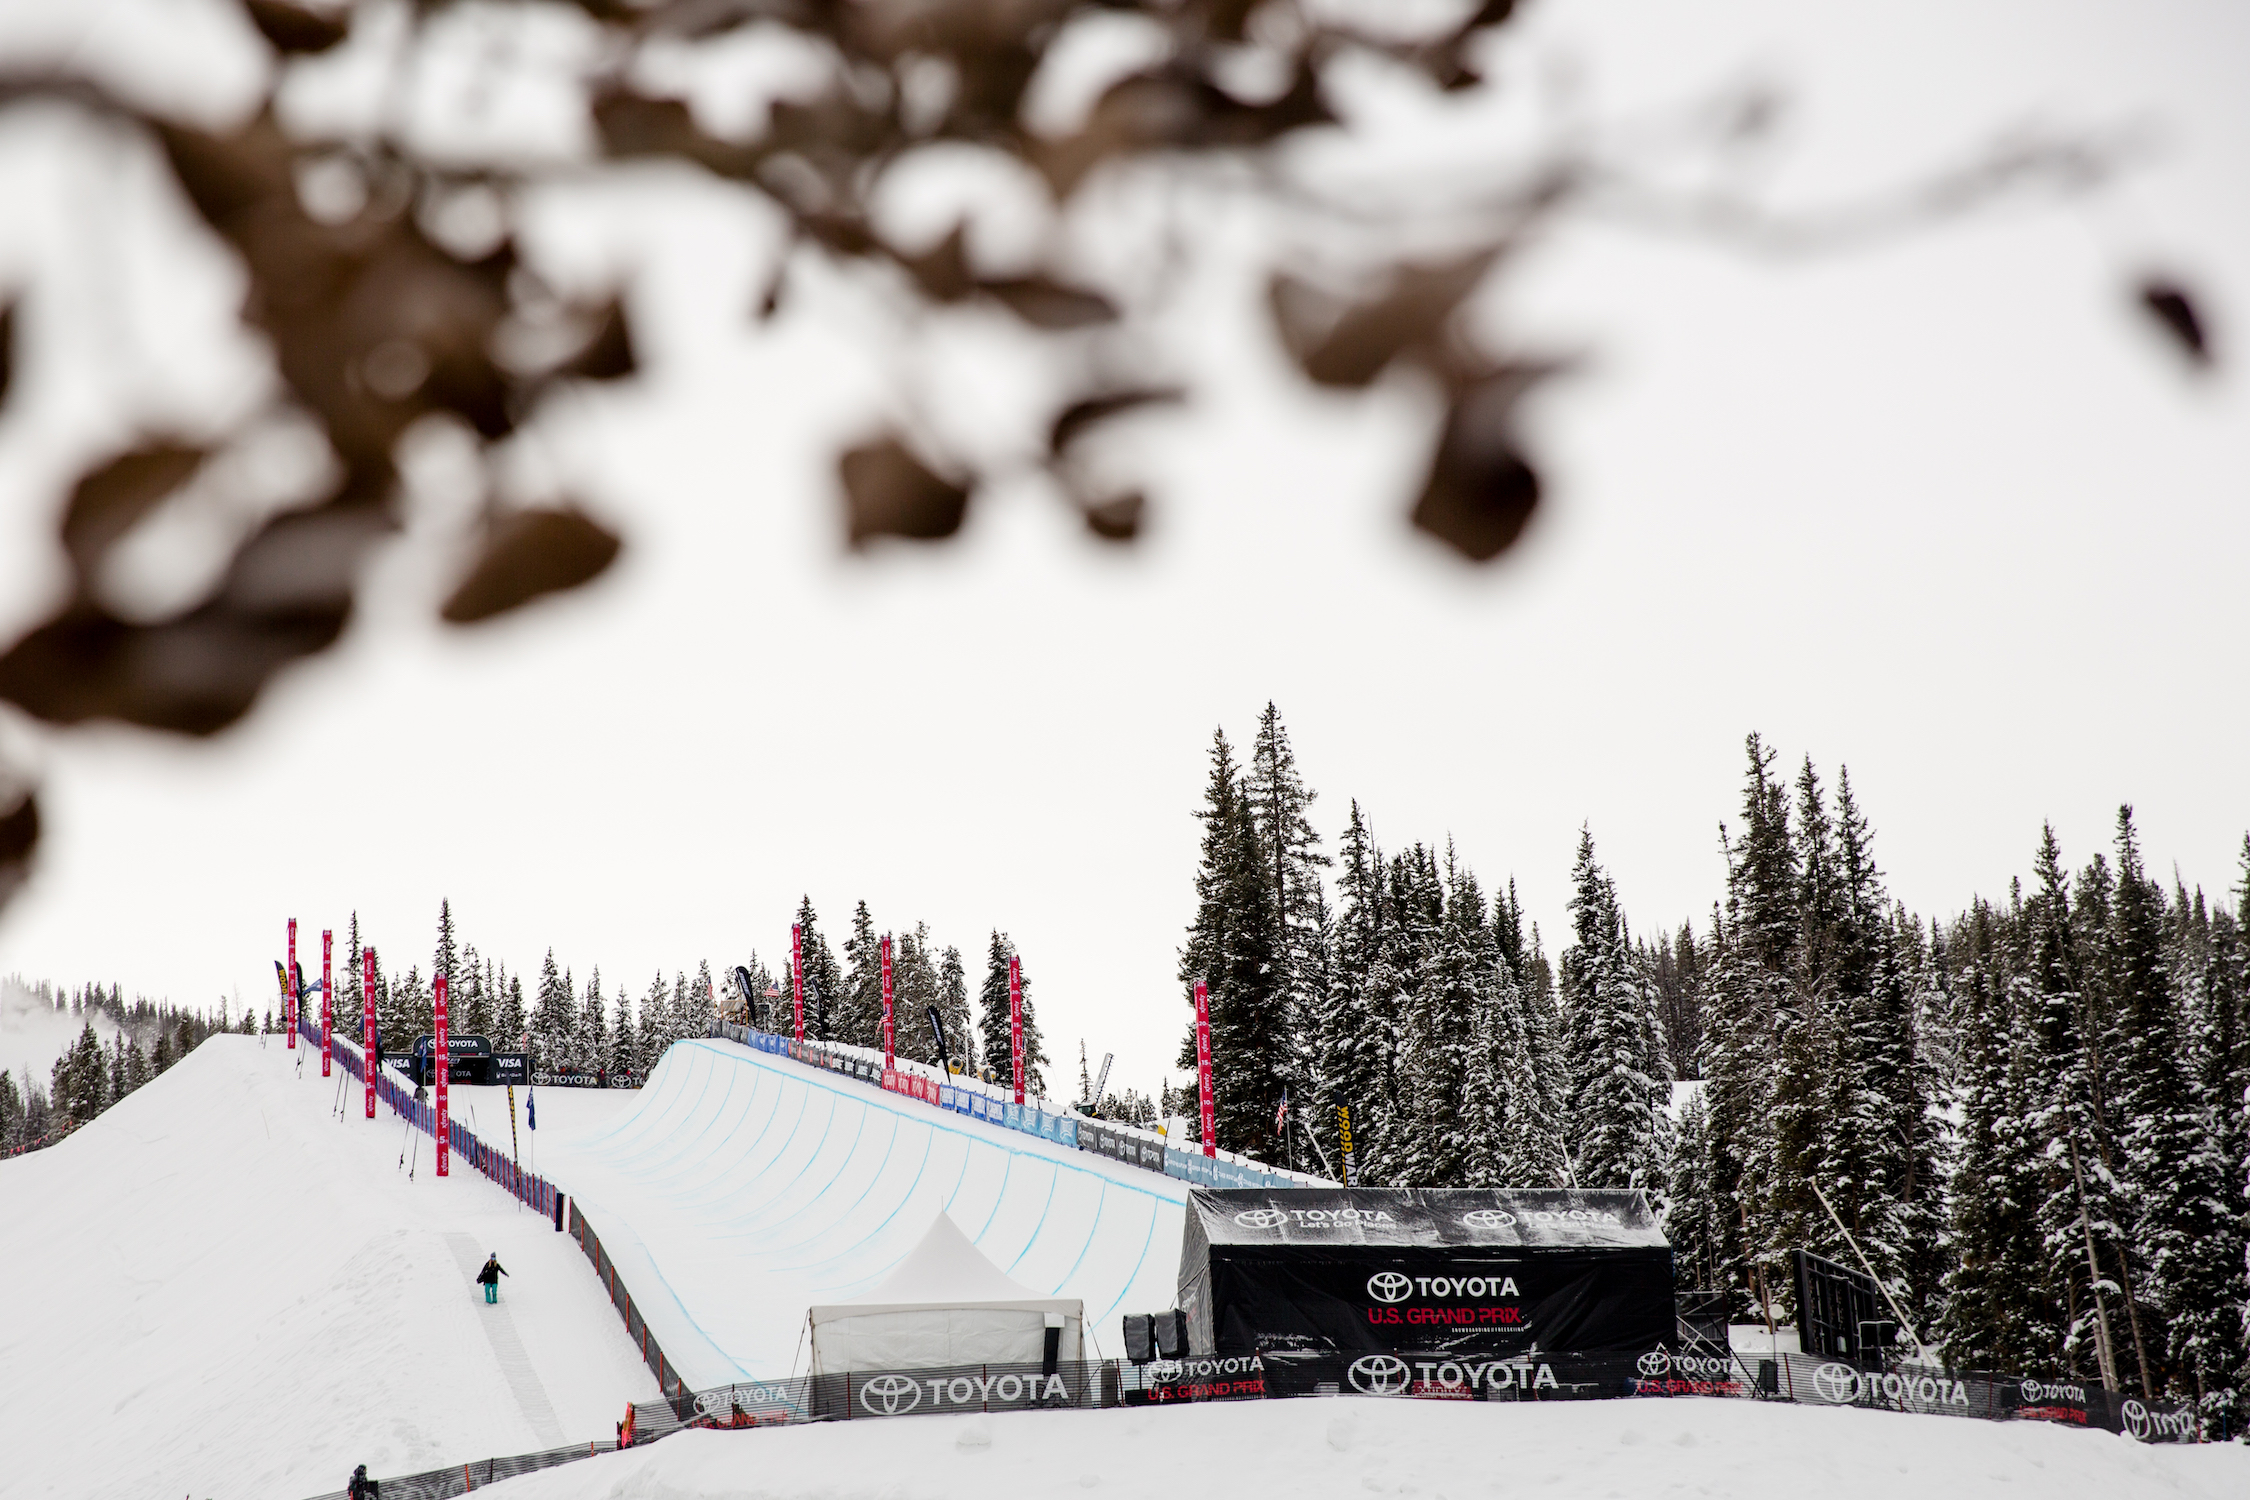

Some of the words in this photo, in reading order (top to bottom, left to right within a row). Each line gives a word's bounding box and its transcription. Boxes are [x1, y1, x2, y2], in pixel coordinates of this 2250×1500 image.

[1198, 994, 1206, 1014] xfinity
[1201, 1033, 1209, 1053] xfinity
[496, 1058, 522, 1068] VISA
[440, 1068, 448, 1088] xfinity
[552, 1075, 598, 1086] TOYOTA
[1203, 1072, 1211, 1093] xfinity
[440, 1109, 448, 1129] xfinity
[1340, 1106, 1358, 1187] WOODWAR
[440, 1152, 448, 1172] xfinity
[1290, 1209, 1394, 1222] TOYOTA
[1300, 1221, 1330, 1229] Let's
[1333, 1221, 1352, 1229] Go
[1518, 1210, 1621, 1224] TOYOTA
[1415, 1277, 1520, 1297] TOYOTA
[1368, 1307, 1404, 1324] U.S.
[1406, 1307, 1476, 1324] GRAND
[1478, 1307, 1522, 1324] PRIX
[1185, 1356, 1265, 1377] TOYOTA
[1671, 1355, 1744, 1374] TOYOTA
[1415, 1361, 1560, 1390] TOYOTA
[720, 1385, 788, 1406] TOYOTA
[926, 1373, 1069, 1405] TOYOTA
[1147, 1386, 1175, 1400] U.S.
[1177, 1382, 1231, 1398] GRAND
[1233, 1380, 1267, 1394] PRIX
[1637, 1379, 1664, 1393] U.S.
[1666, 1379, 1714, 1394] GRAND
[1865, 1372, 1970, 1406] TOYOTA
[2042, 1384, 2087, 1404] TOYOTA
